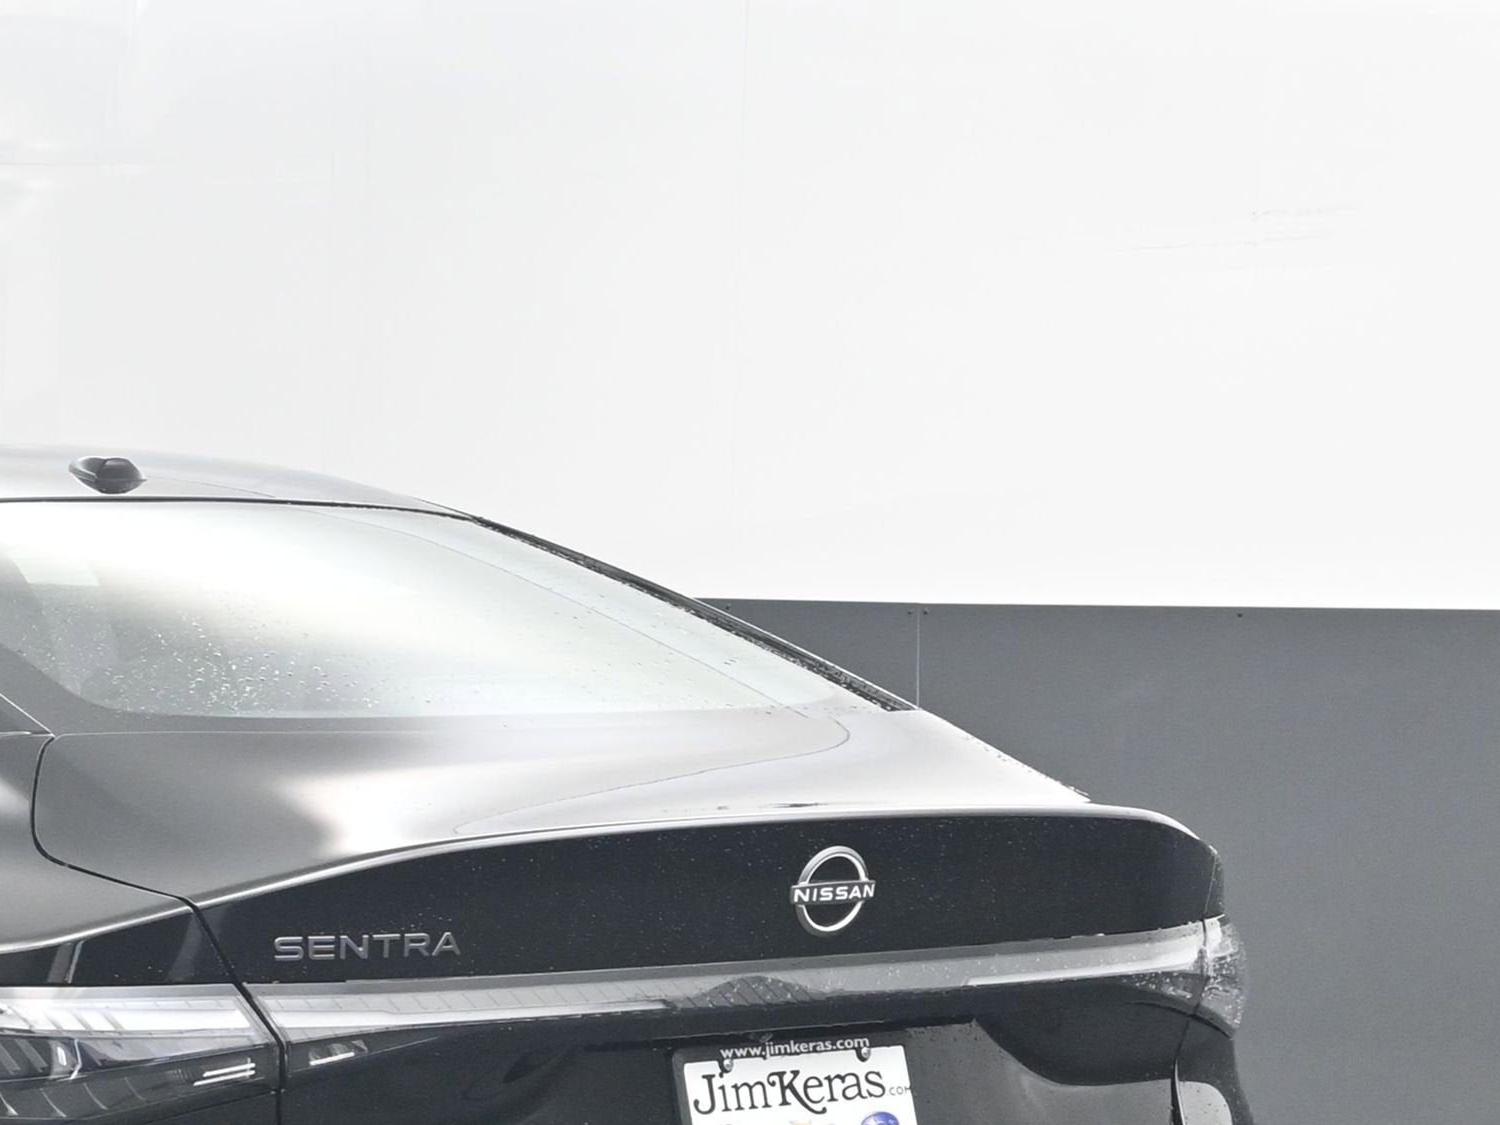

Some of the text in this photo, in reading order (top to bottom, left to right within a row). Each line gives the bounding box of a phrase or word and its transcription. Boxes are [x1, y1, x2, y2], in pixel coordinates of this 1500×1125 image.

[793, 883, 876, 903] NISSAN
[273, 931, 461, 962] SENTRA
[719, 1036, 870, 1060] www.jimkeras.com
